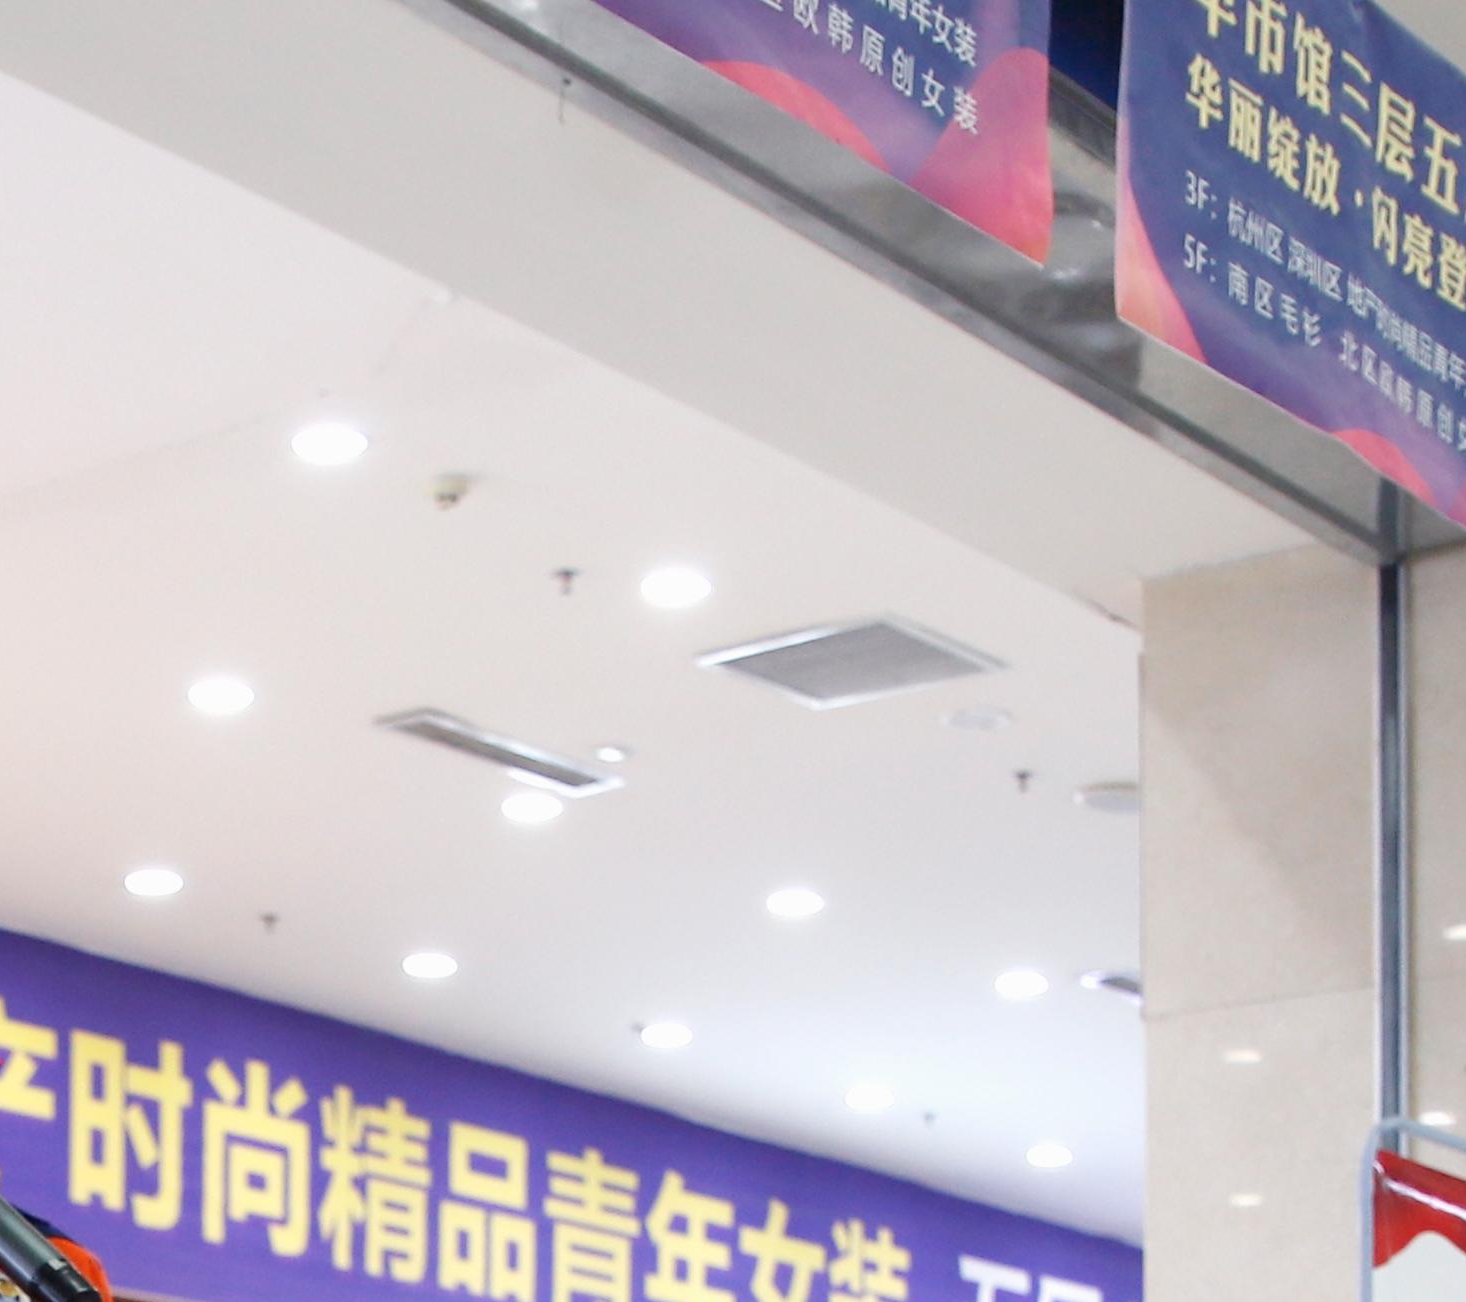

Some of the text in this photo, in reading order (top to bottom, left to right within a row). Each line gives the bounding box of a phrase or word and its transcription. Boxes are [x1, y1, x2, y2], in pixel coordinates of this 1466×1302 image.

[768, 0, 978, 135] 欧韩原创女装
